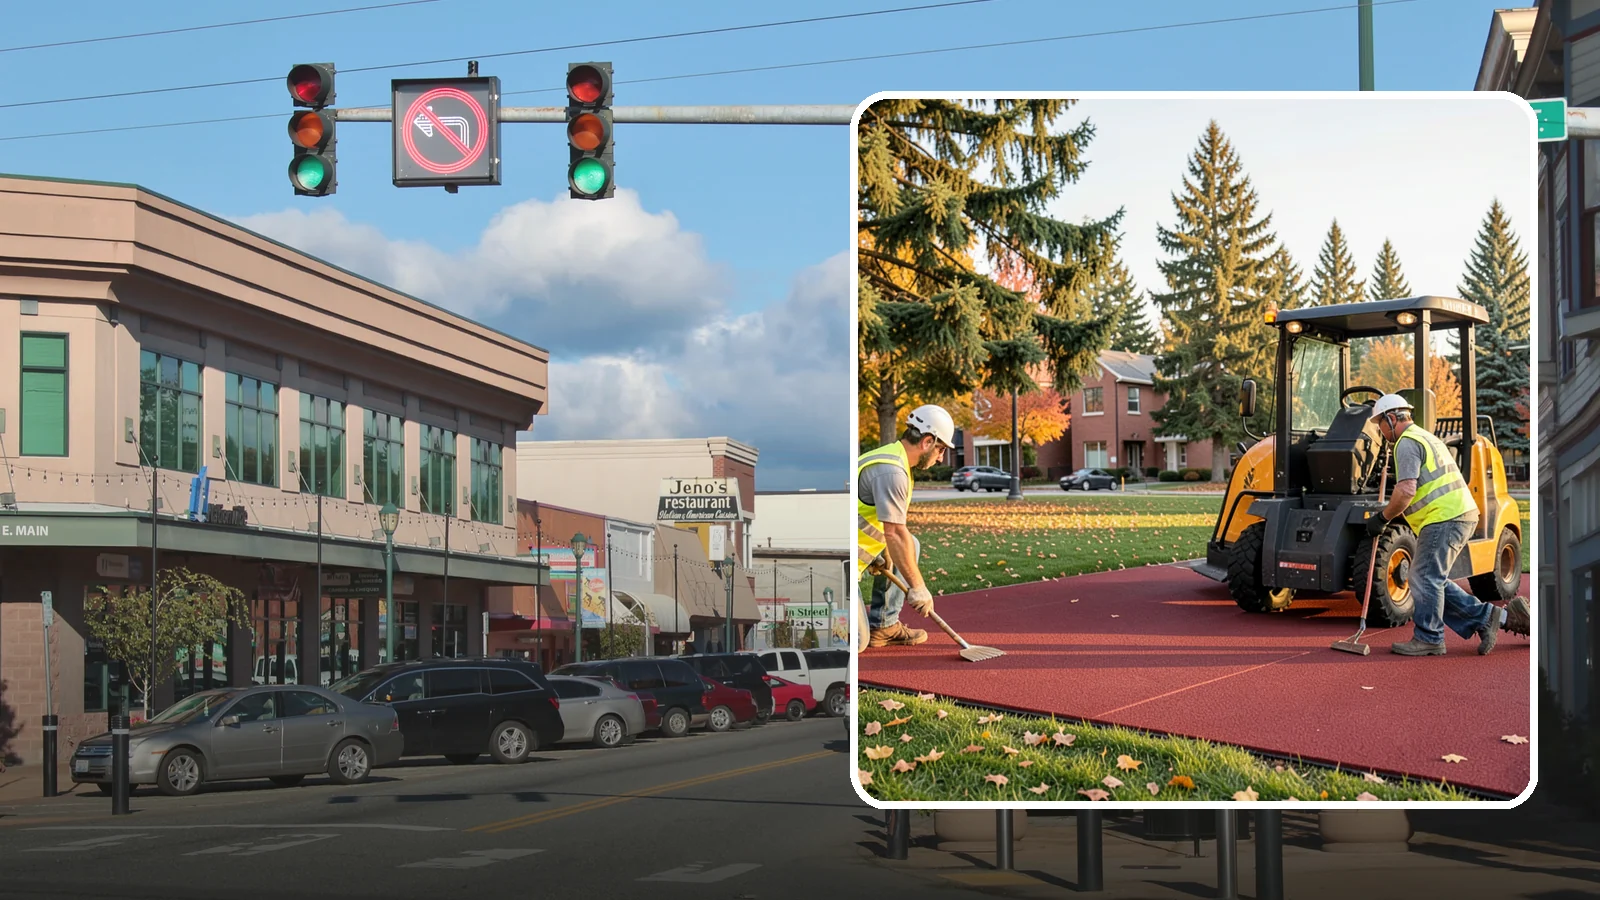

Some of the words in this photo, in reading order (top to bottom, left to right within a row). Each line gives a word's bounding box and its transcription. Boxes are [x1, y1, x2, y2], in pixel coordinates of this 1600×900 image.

[669, 480, 727, 495] Jeno's
[665, 496, 731, 509] restaurant
[658, 509, 681, 519] Italian
[686, 508, 714, 519] American
[715, 509, 737, 519] Cuisine
[2, 525, 13, 536] E.
[15, 525, 49, 536] MAIN
[797, 607, 828, 617] Street
[791, 619, 823, 627] lass
